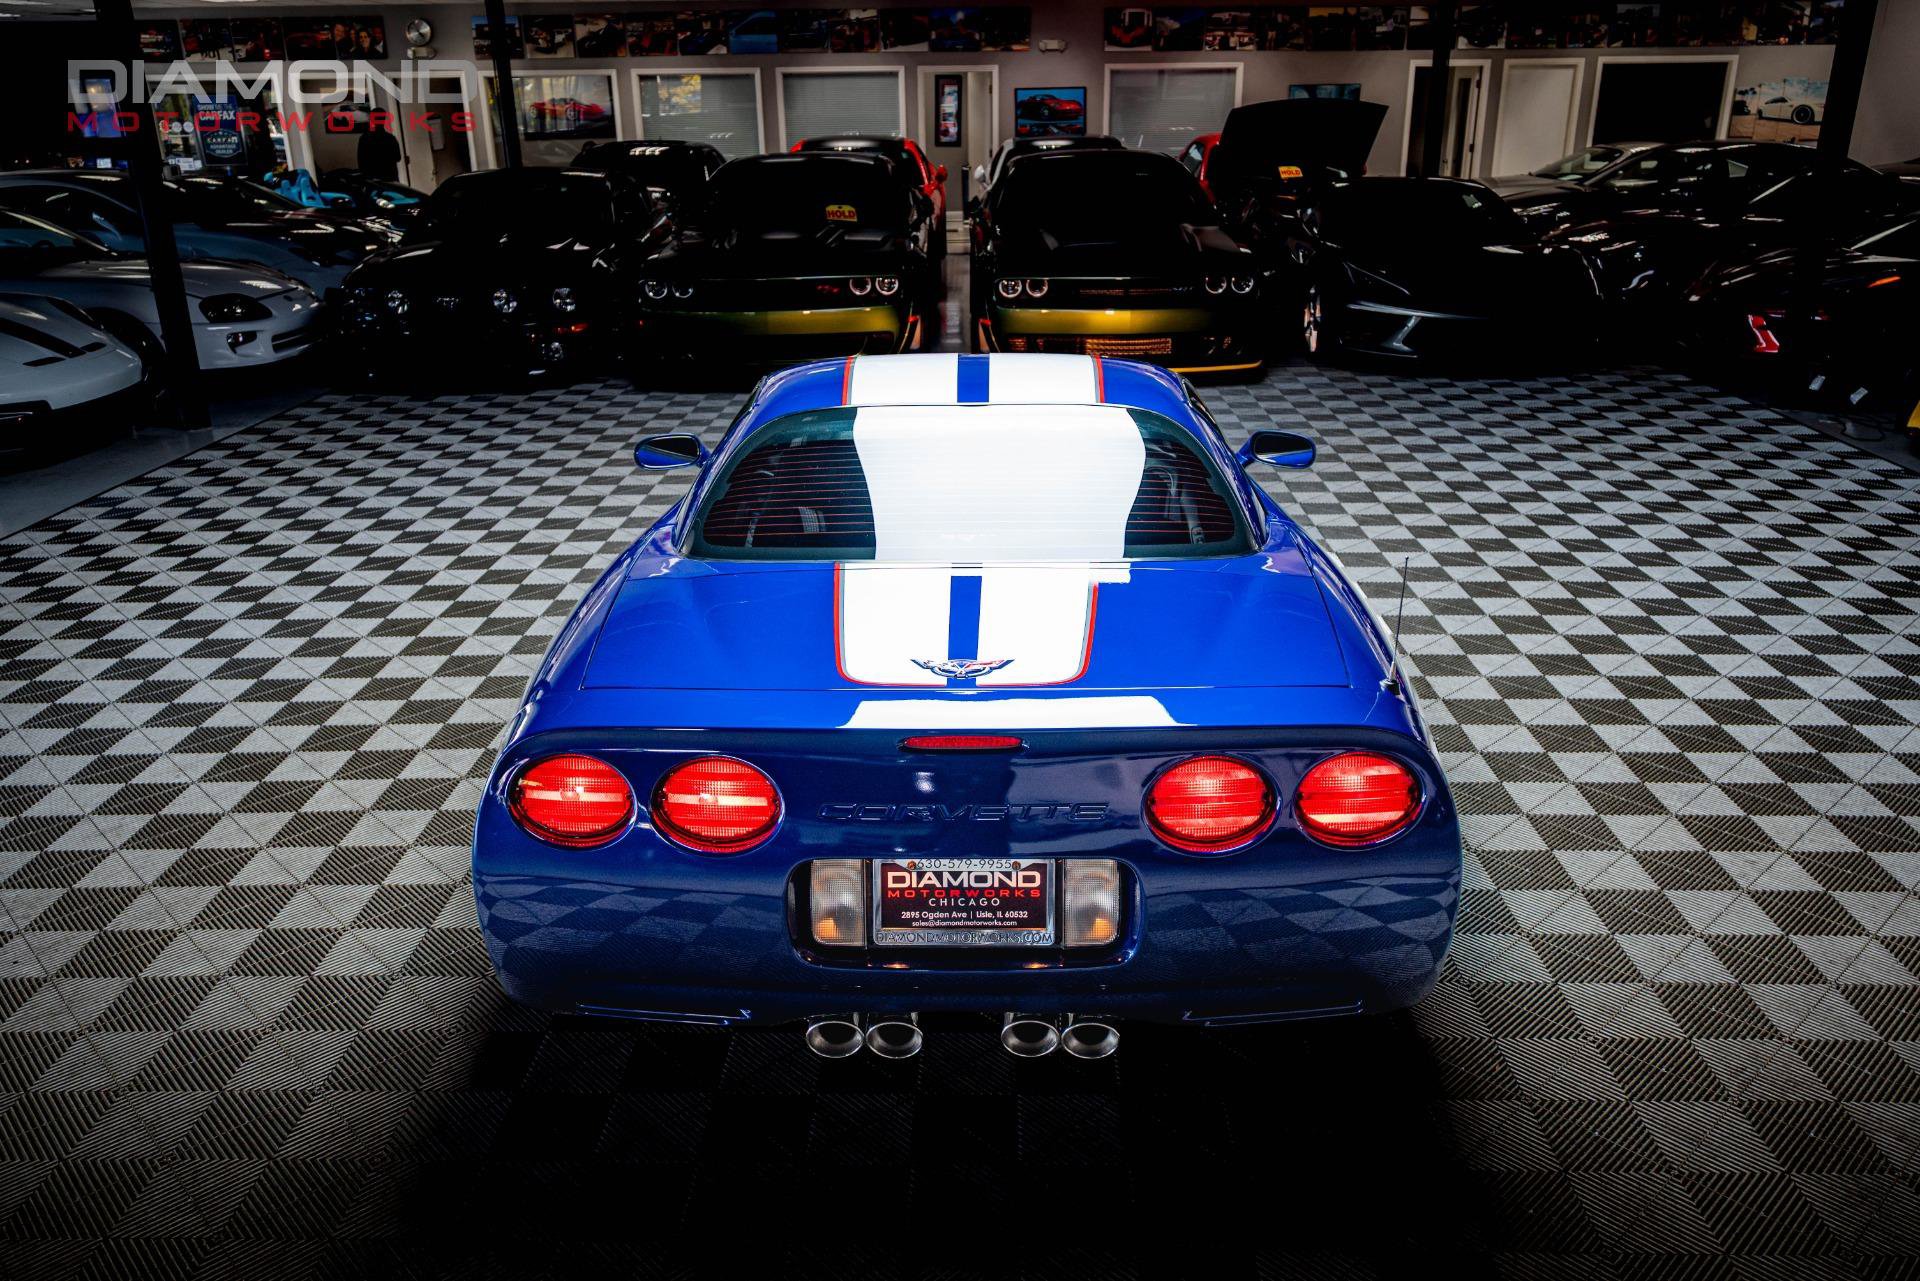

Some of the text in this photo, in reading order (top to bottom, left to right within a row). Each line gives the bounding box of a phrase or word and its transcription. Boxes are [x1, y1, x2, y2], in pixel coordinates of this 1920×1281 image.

[827, 210, 856, 218] HOLD
[815, 801, 1110, 824] CORVETTE
[916, 858, 1012, 869] 630-579-9955
[887, 871, 1041, 888] DIAMOND
[887, 889, 1041, 898] MOTORWORKS
[928, 897, 1000, 906] CHICAGO
[921, 911, 949, 920] Ogden
[912, 919, 1018, 927] sales@diamondmotorworks.com
